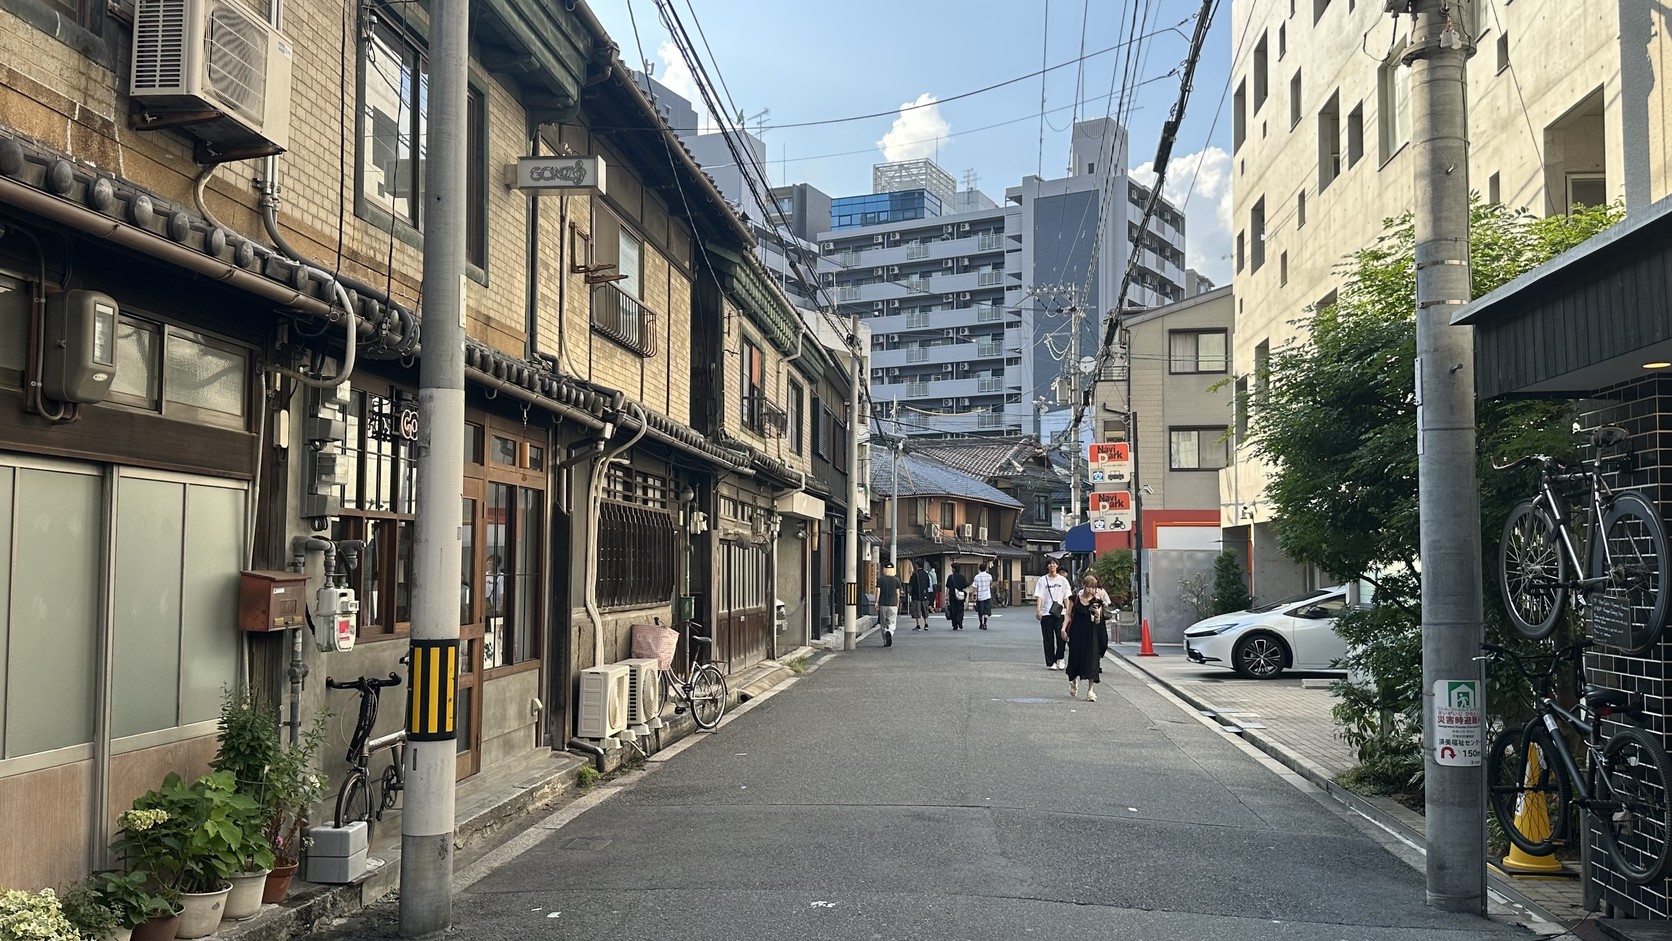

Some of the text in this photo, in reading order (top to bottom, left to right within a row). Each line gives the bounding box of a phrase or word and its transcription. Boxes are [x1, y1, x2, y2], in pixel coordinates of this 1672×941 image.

[1097, 445, 1116, 453] Navi
[1098, 450, 1122, 469] Park
[1098, 493, 1116, 502] Navi
[1099, 499, 1124, 518] Park
